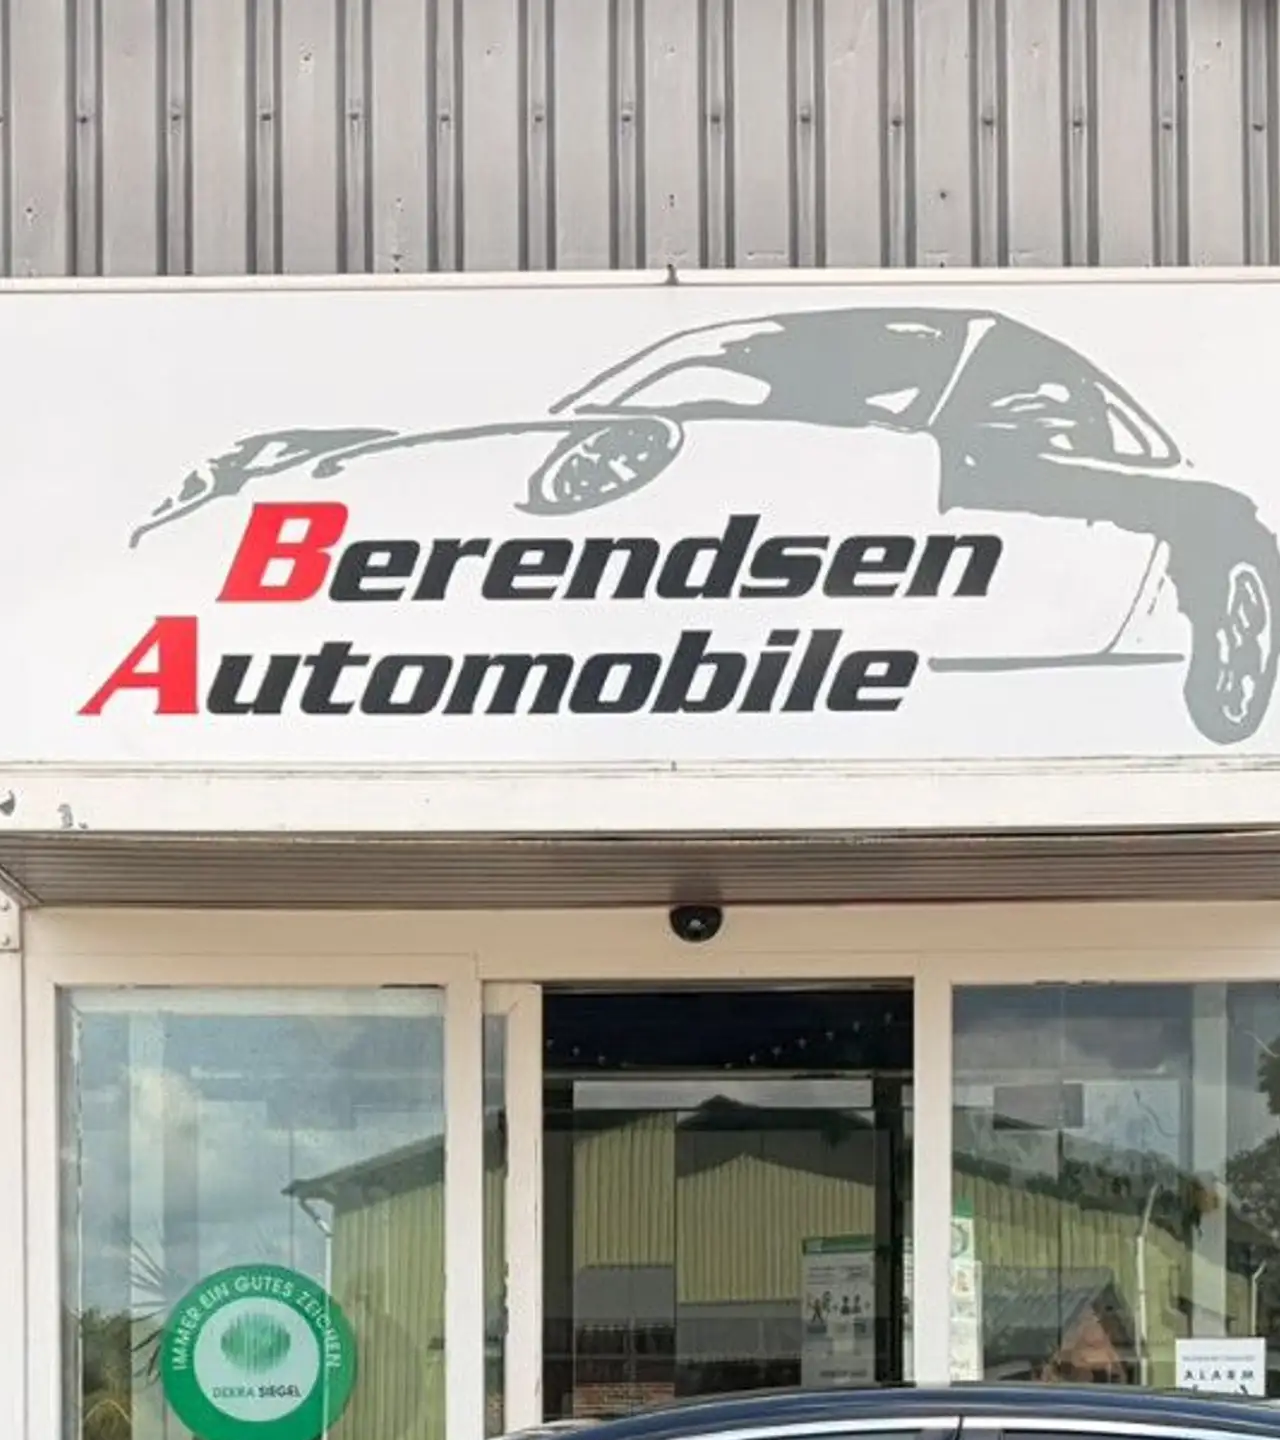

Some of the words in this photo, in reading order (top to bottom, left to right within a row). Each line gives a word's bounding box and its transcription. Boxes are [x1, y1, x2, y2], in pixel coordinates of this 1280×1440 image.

[216, 502, 1002, 602] Berendsen
[77, 616, 919, 716] Automobile
[172, 1306, 202, 1371] IMMER
[199, 1284, 230, 1309] EIN
[234, 1275, 295, 1298] GUTES
[295, 1291, 342, 1368] ZEICHEN
[258, 1384, 302, 1399] SIEGEL
